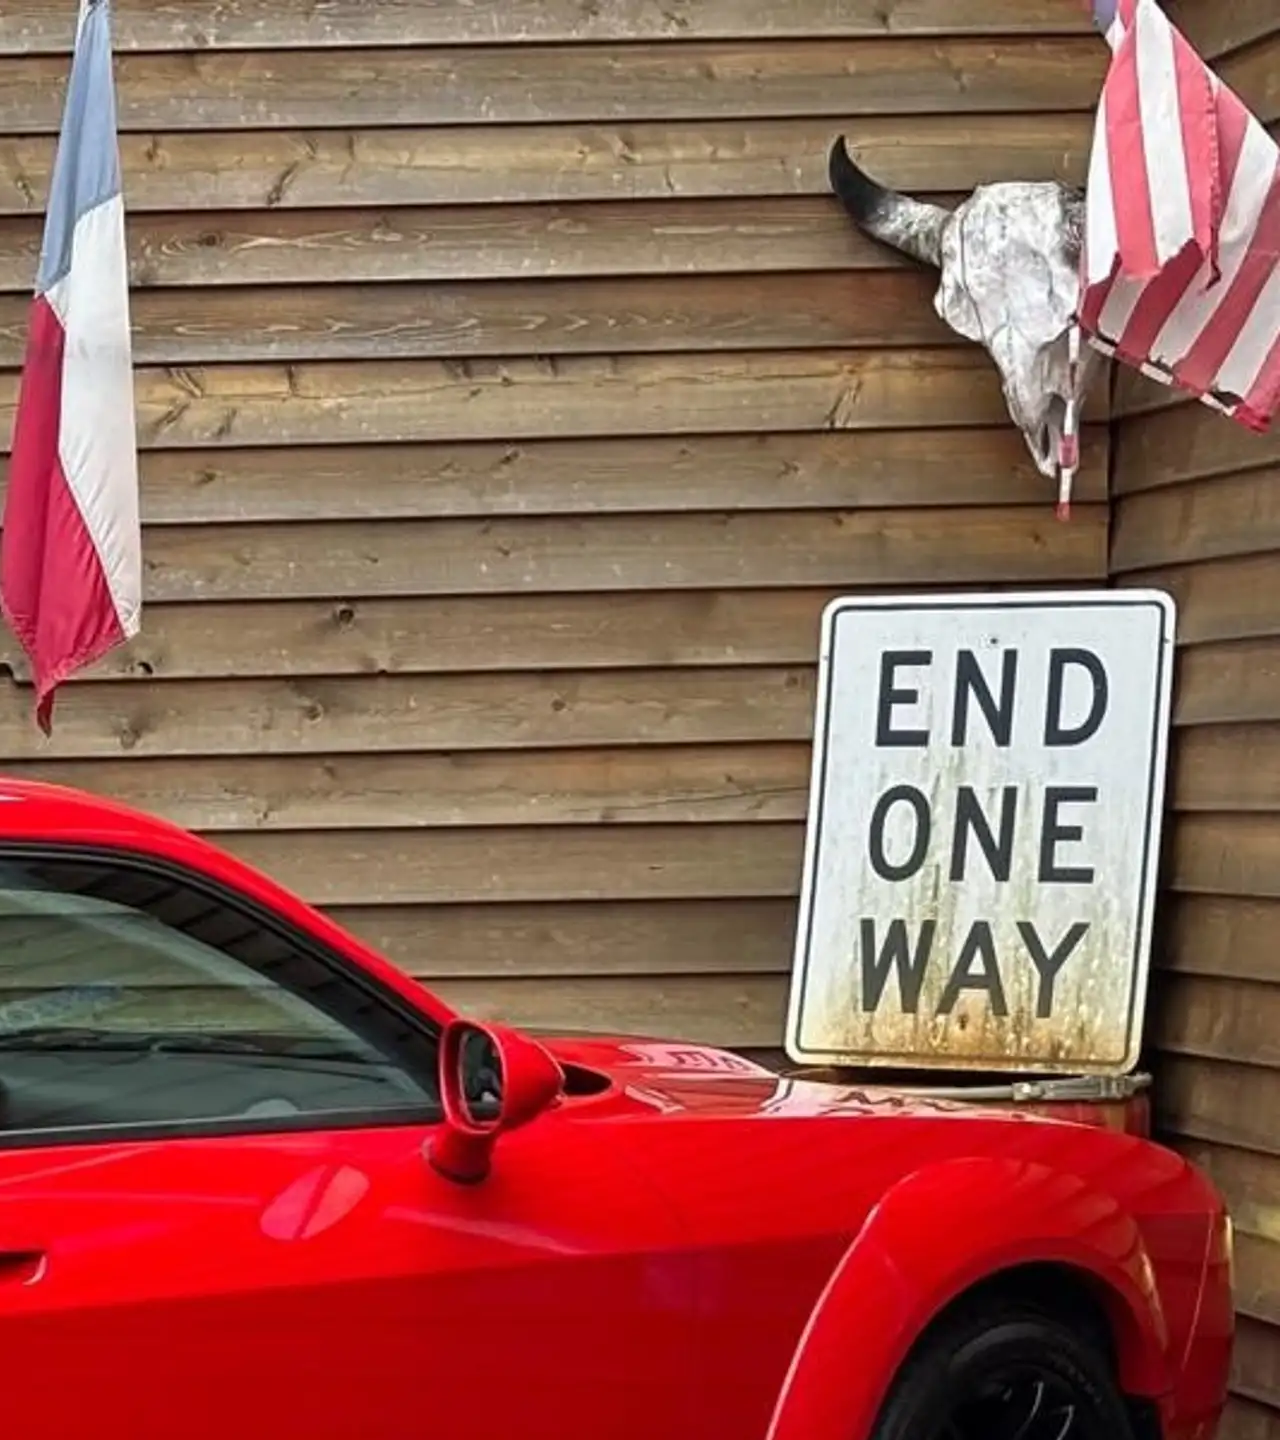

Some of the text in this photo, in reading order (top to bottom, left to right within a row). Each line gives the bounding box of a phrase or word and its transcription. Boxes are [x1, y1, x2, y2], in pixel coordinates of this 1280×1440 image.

[874, 648, 1109, 747] END
[869, 784, 1100, 884] ONE
[859, 919, 1092, 1018] WAY
